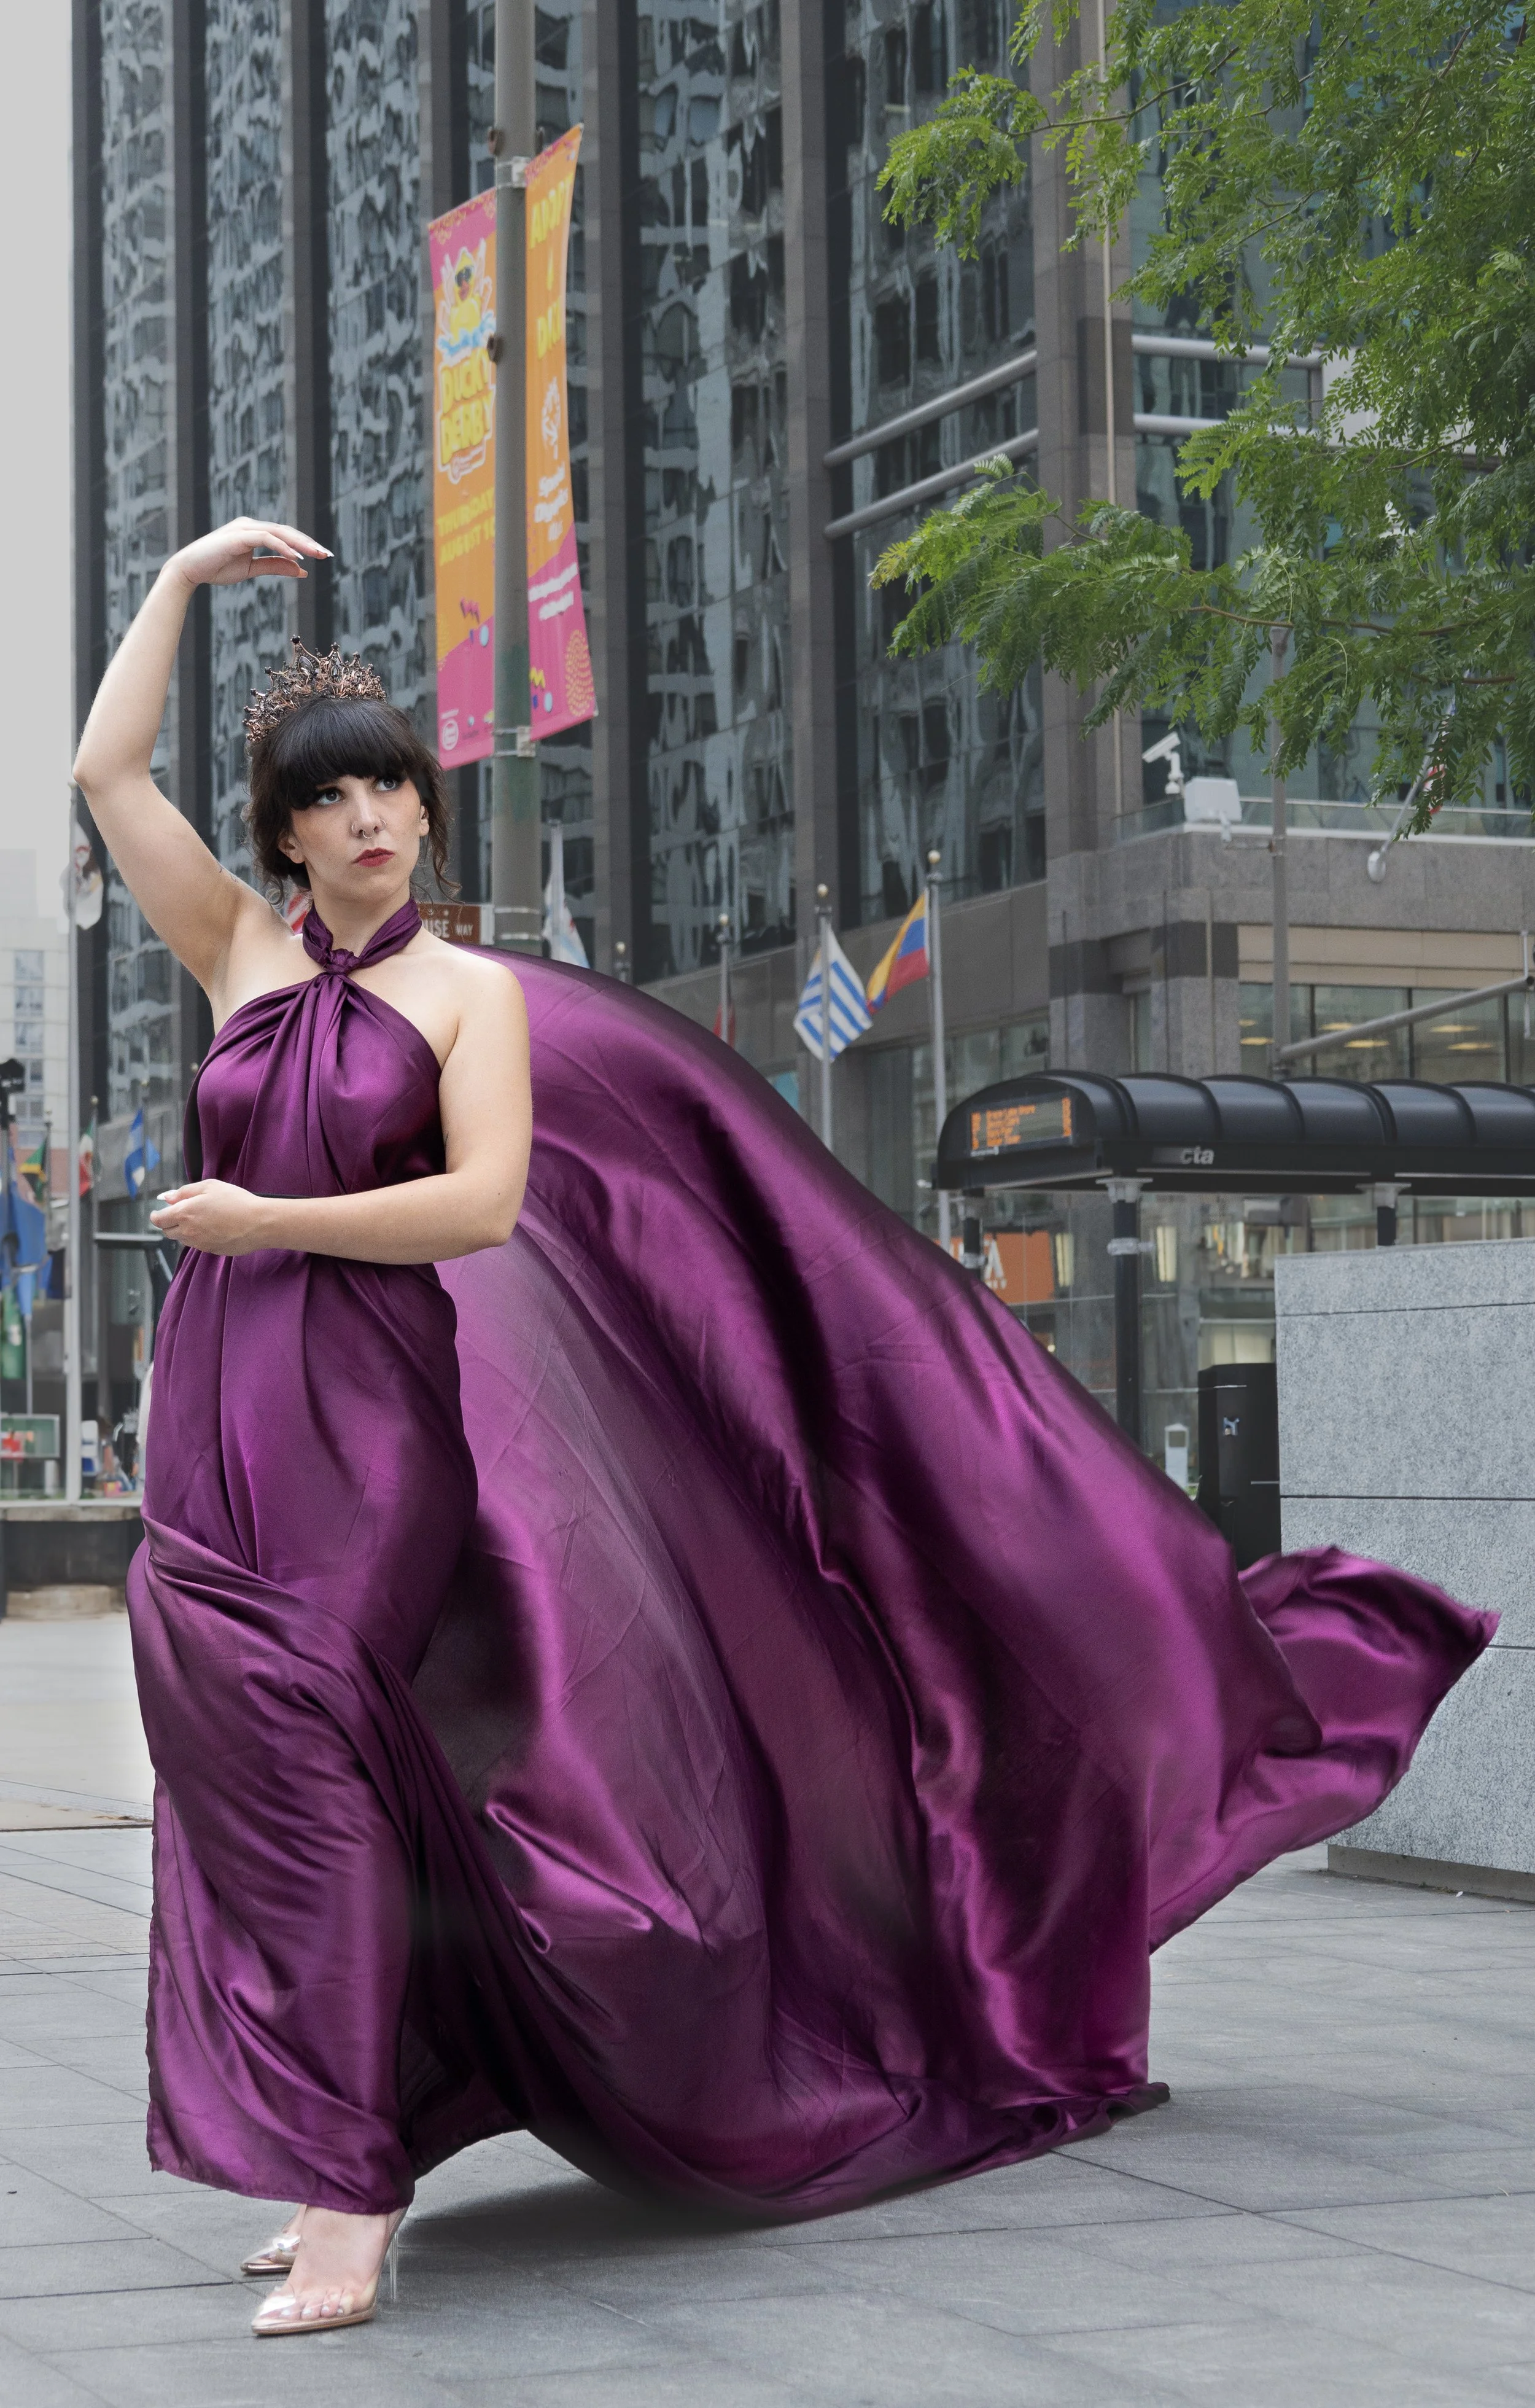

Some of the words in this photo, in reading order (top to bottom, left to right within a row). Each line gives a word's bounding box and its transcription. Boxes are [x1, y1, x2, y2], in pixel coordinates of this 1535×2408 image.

[441, 346, 489, 413] DUCKY
[441, 389, 494, 465] DERBY
[438, 487, 494, 537] THURSDAY
[440, 524, 481, 566] AUGUST
[455, 924, 473, 936] WAY
[1179, 1145, 1214, 1164] cta
